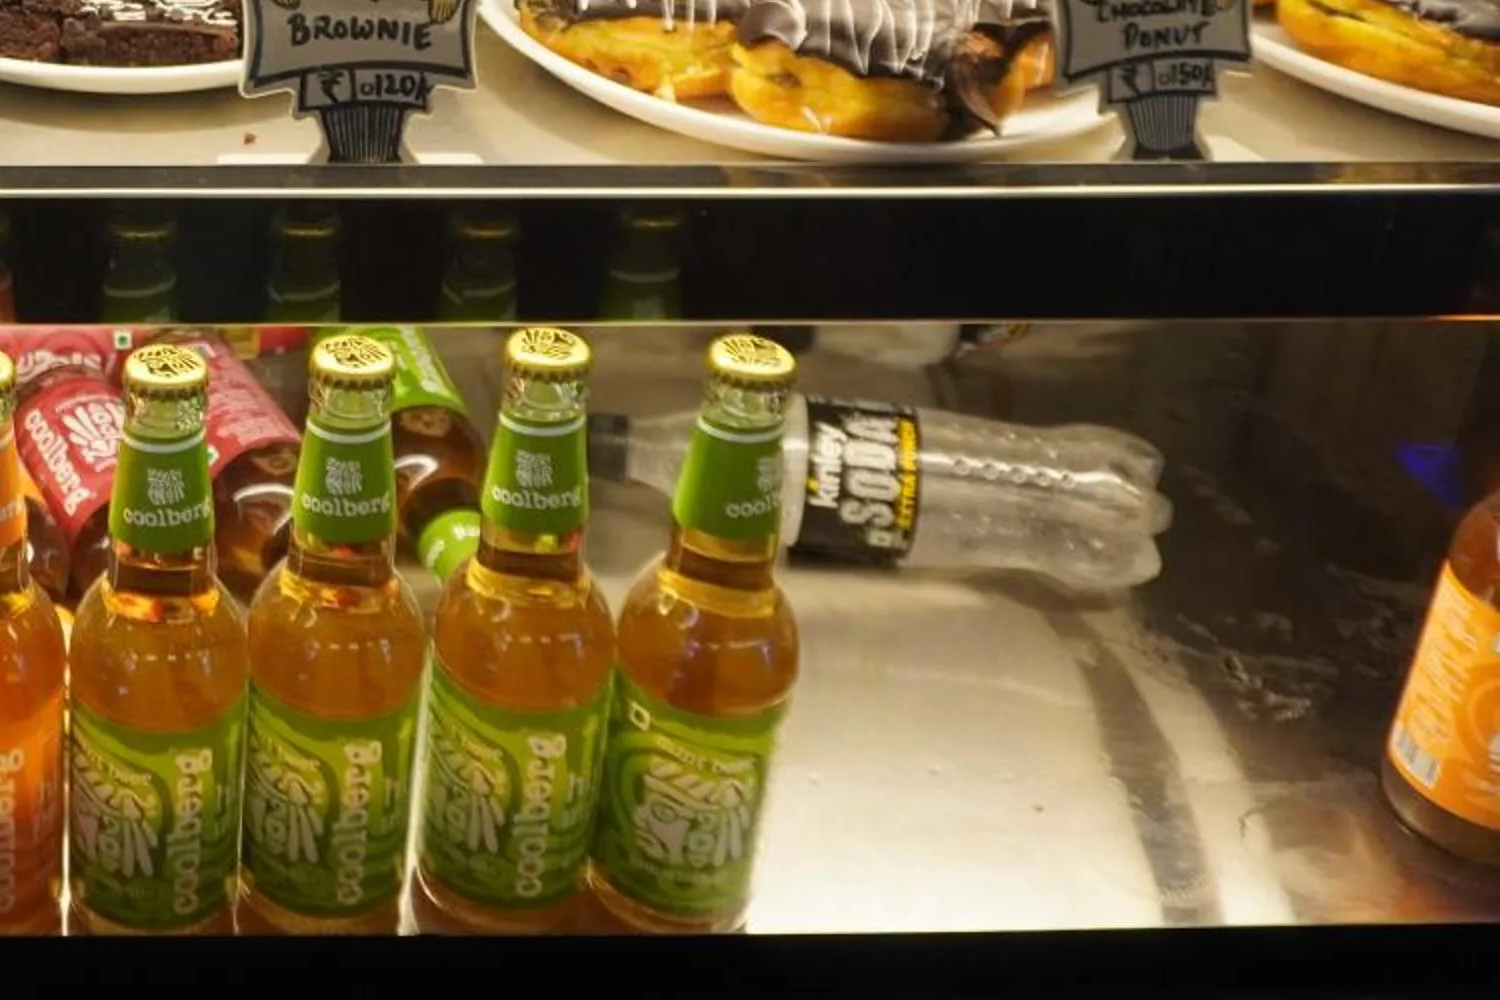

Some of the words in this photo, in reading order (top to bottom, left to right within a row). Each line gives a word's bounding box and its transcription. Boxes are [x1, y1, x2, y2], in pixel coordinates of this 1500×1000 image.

[287, 12, 434, 50] BROWNIE
[23, 407, 94, 517] coolberg
[839, 412, 901, 528] SODA
[166, 747, 214, 915] coolberg
[331, 739, 383, 904] coolberg
[512, 732, 567, 897] coolberg
